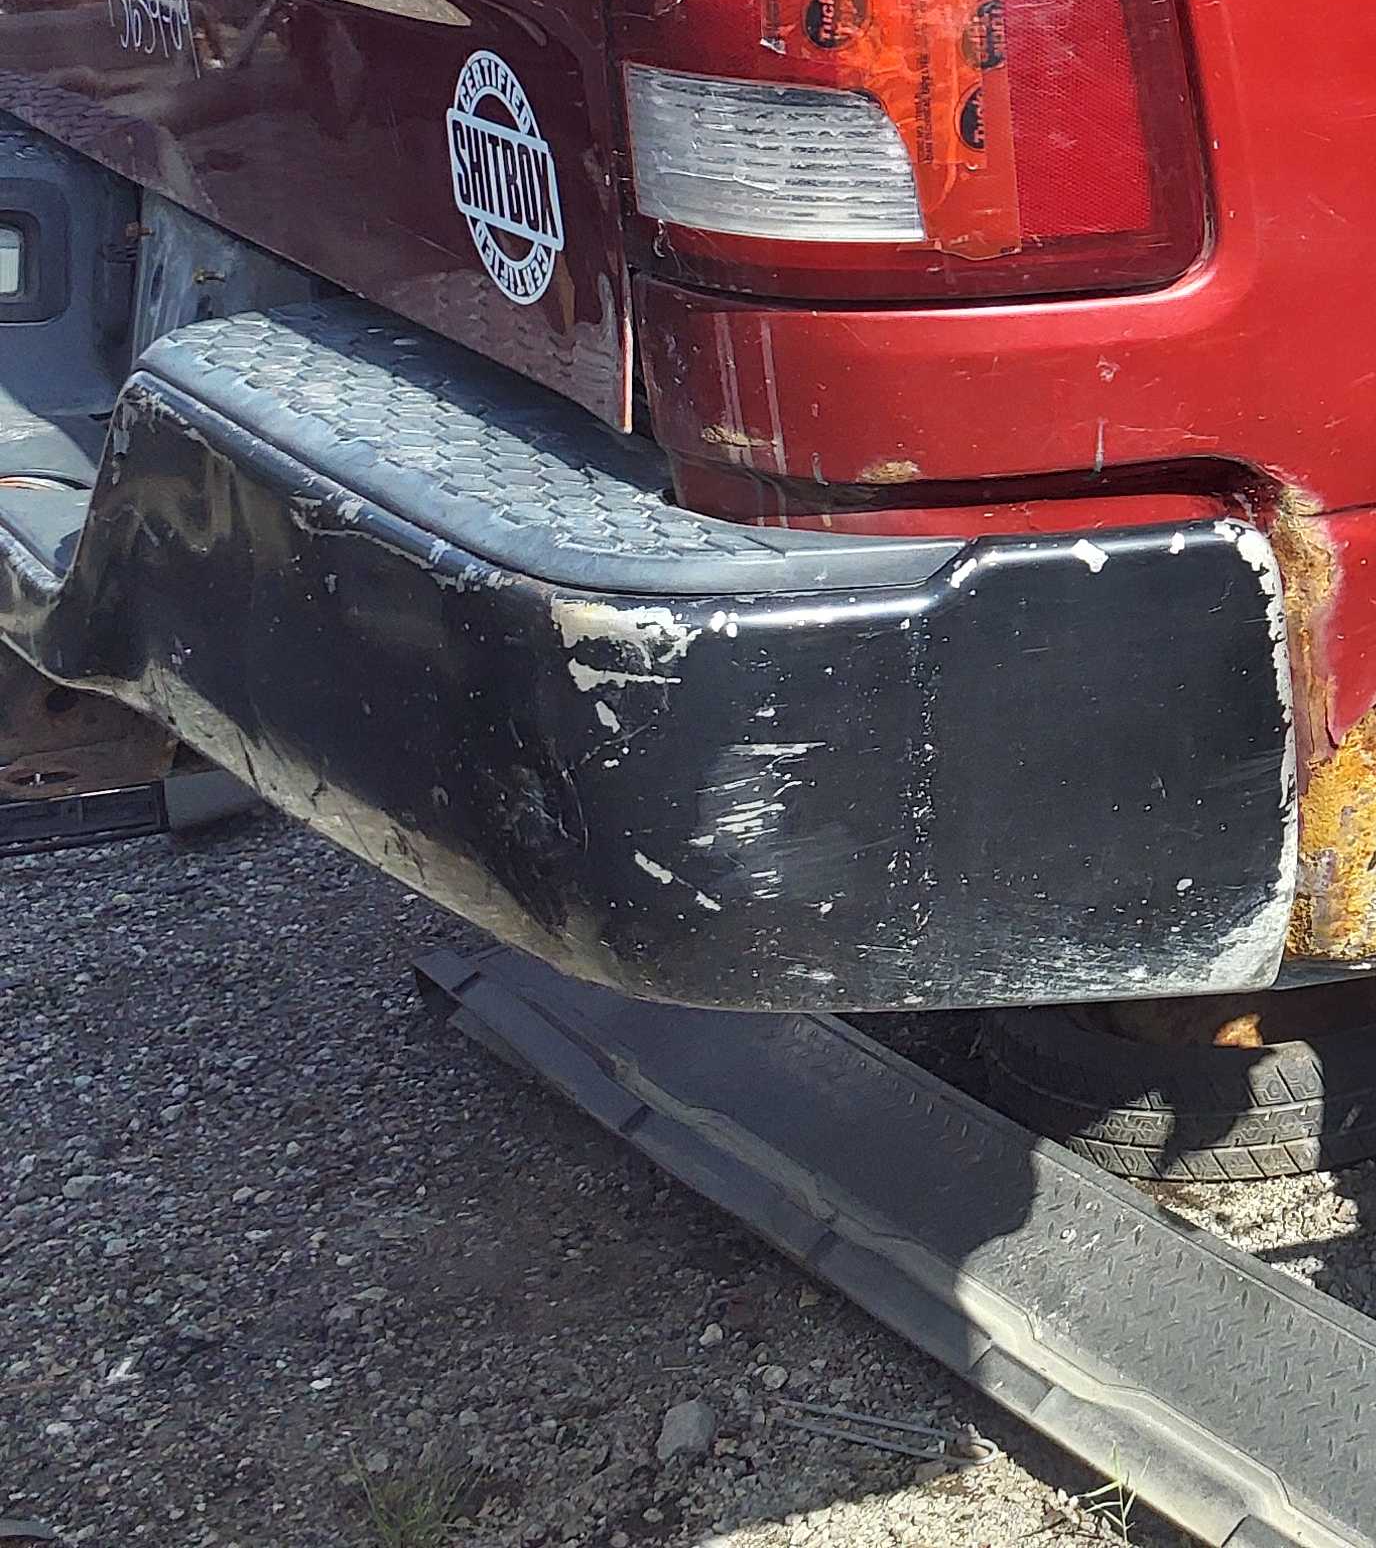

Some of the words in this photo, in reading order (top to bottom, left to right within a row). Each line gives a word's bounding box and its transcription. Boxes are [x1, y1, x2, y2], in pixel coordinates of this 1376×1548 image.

[457, 56, 534, 137] CERTIFIED
[451, 118, 560, 241] SHITBOX
[474, 220, 552, 297] CERTIFIED
